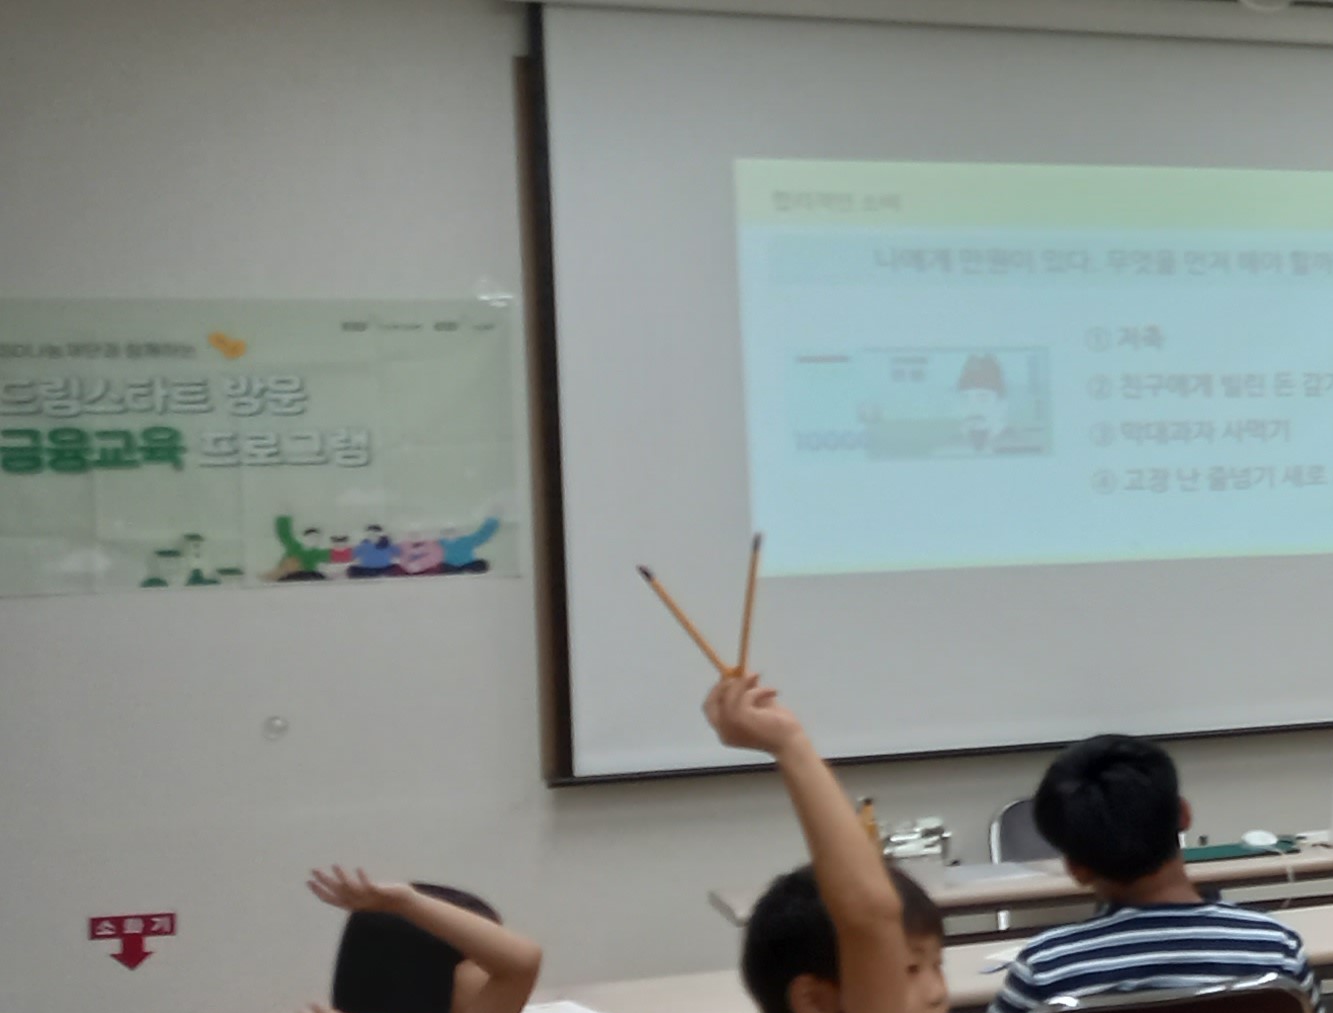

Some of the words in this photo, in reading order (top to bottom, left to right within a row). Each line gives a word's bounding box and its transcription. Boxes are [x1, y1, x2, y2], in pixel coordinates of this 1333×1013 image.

[1105, 248, 1176, 275] 무엇을
[1183, 249, 1230, 274] 먼저
[1116, 322, 1166, 351] 저축
[1, 376, 213, 419] 드림스타트
[224, 373, 310, 418] 방문
[1120, 371, 1213, 400] 친구에게
[1220, 371, 1266, 399] 빌린
[1274, 371, 1297, 398] 돈
[1, 424, 187, 475] 금융교육
[199, 424, 373, 470] 프로그램
[1123, 465, 1170, 494] 고장
[1176, 465, 1202, 492] 난
[1206, 463, 1276, 491] 줄넘기
[94, 915, 172, 936] 소화기
